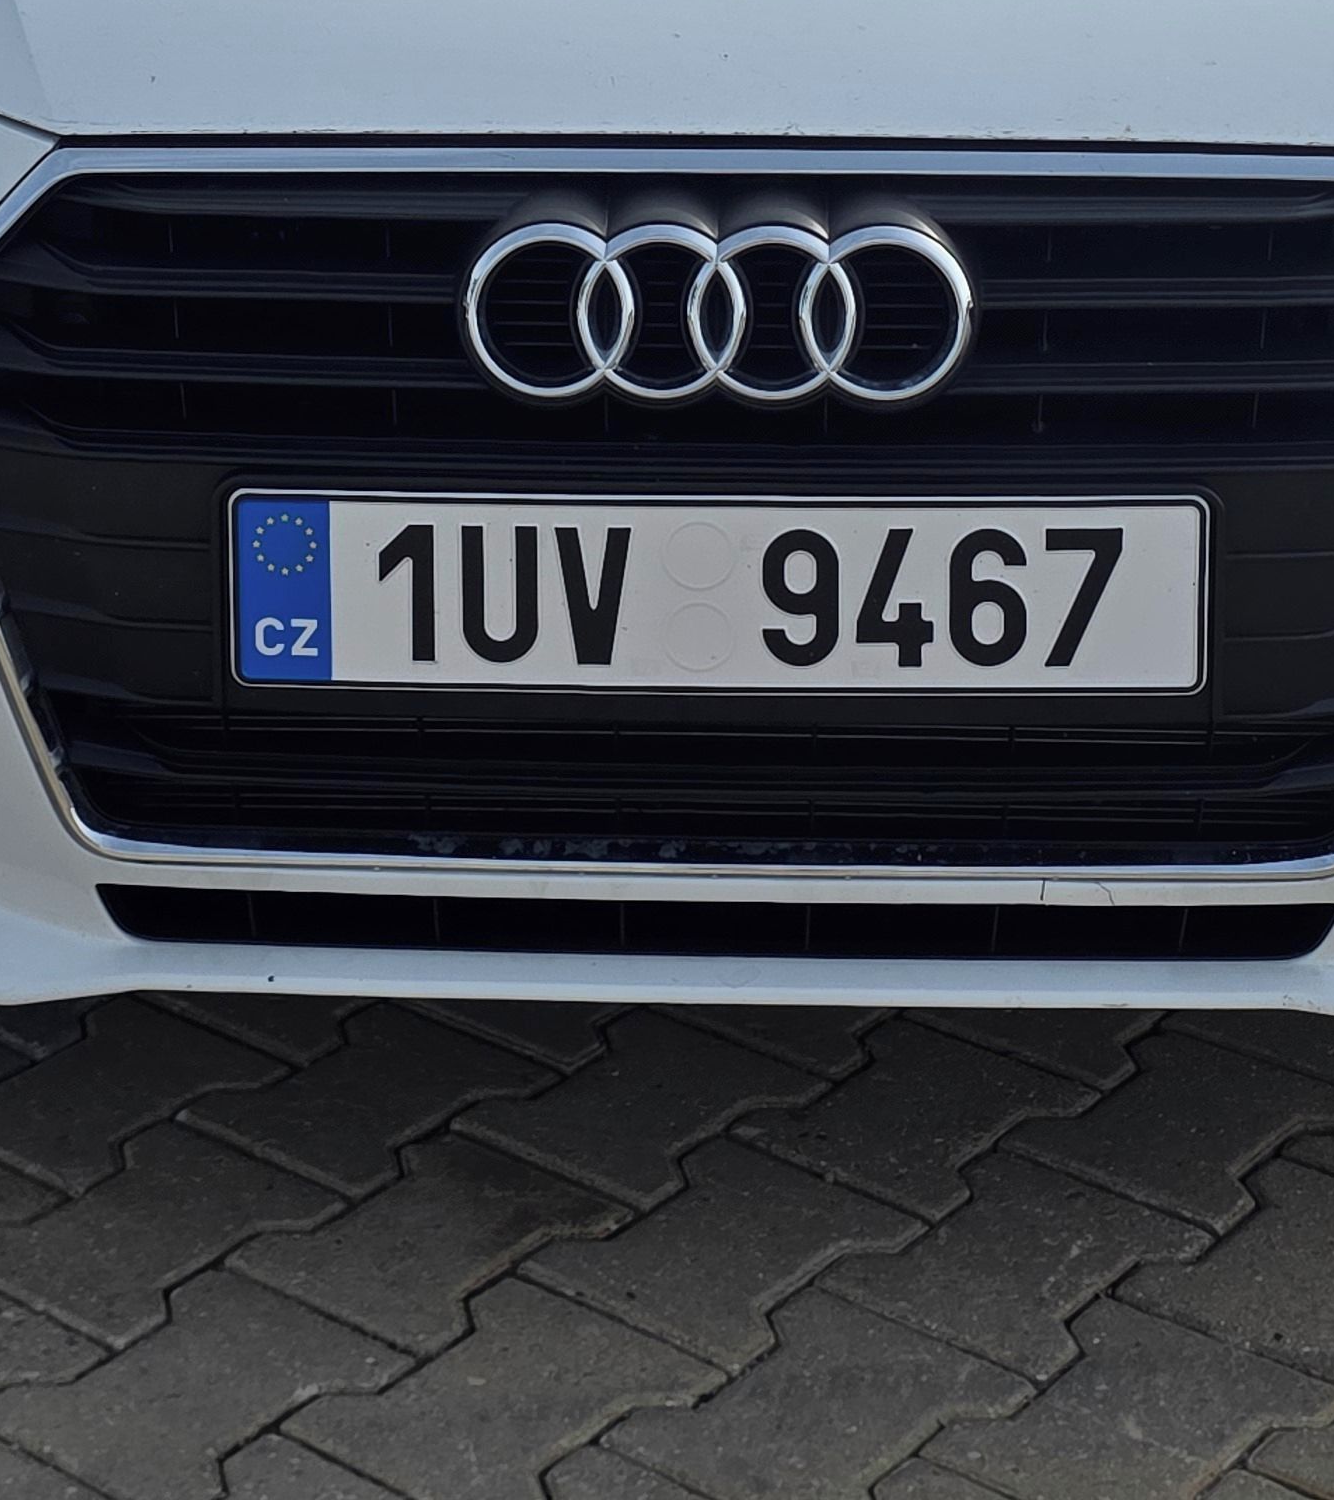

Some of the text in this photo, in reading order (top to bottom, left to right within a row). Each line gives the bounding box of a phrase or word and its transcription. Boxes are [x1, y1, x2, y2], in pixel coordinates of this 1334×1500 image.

[255, 617, 318, 656] CZ
[378, 524, 1124, 668] 1UV 9467
